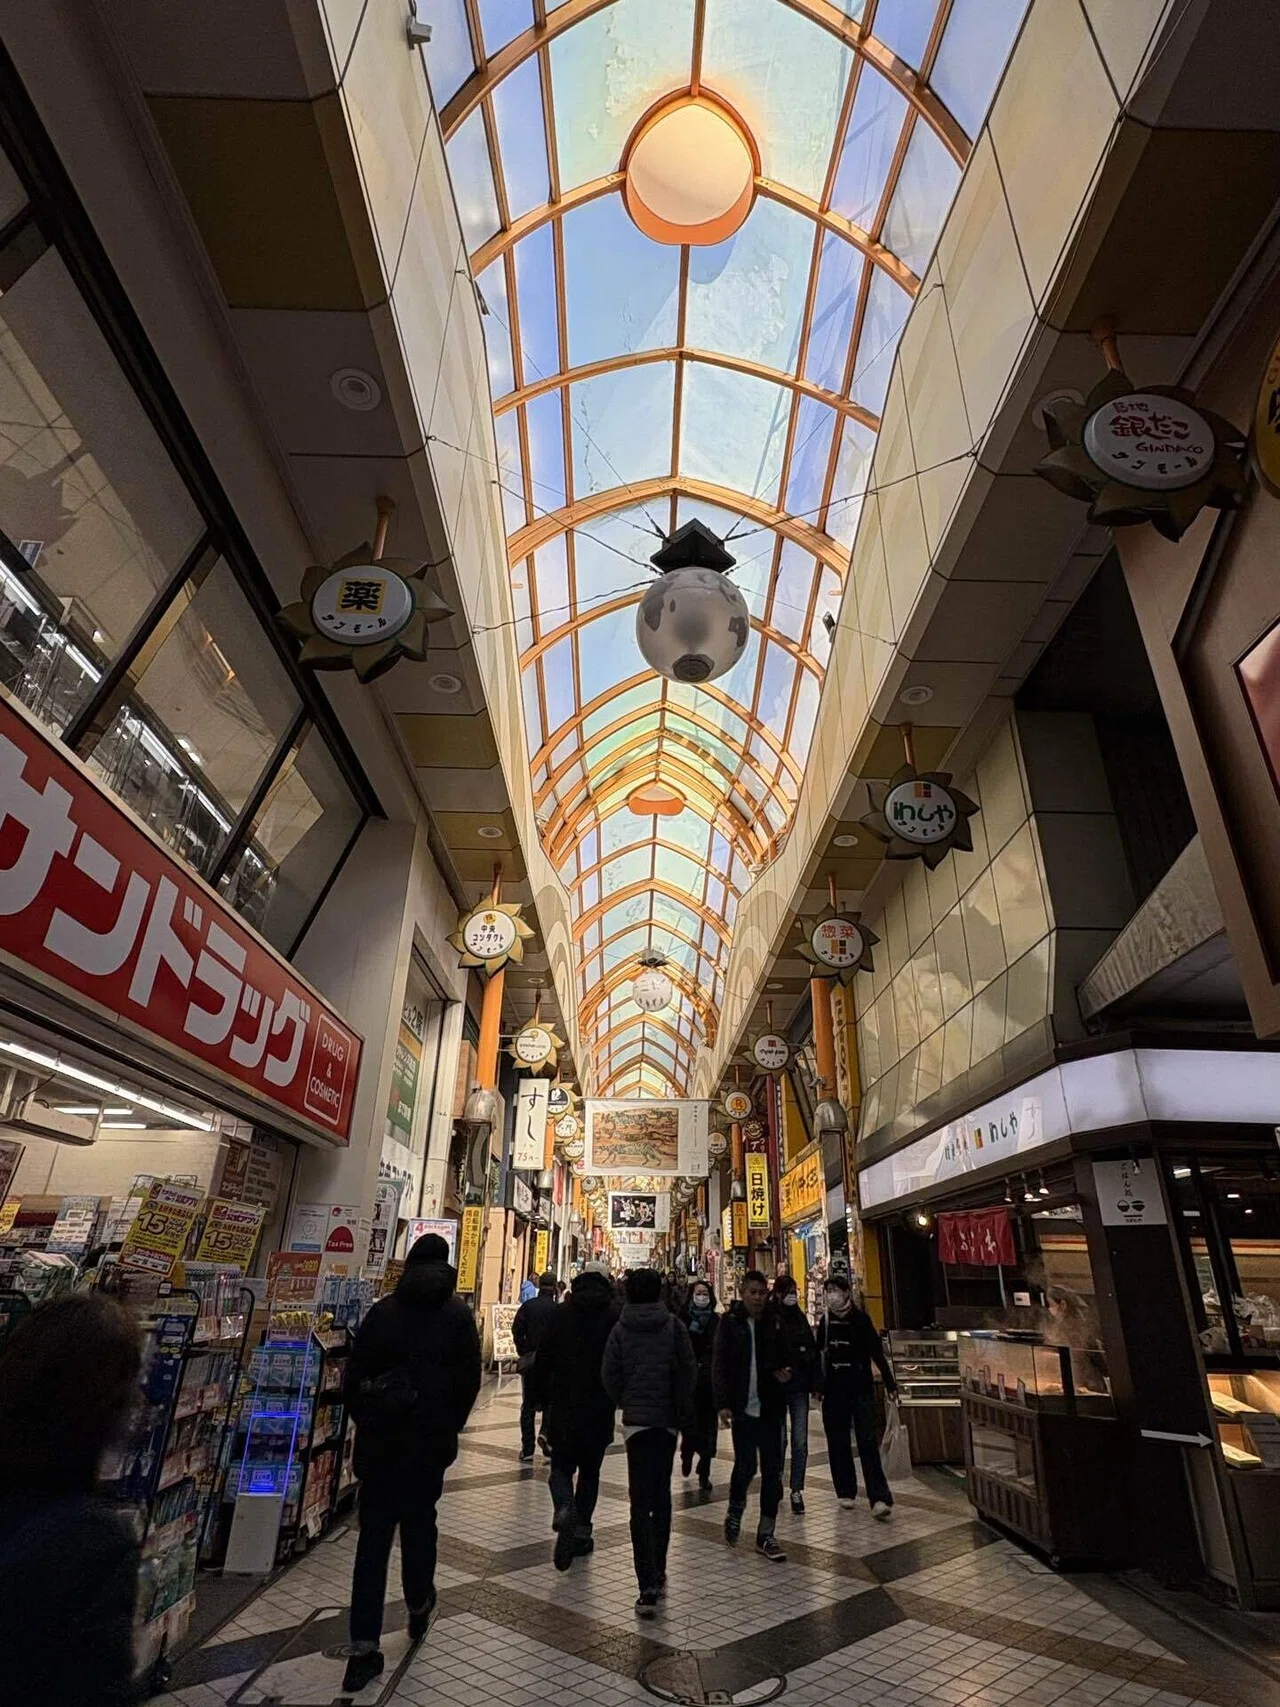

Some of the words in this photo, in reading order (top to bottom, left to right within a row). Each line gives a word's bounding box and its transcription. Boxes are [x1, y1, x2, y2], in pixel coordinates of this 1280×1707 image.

[1109, 412, 1190, 441] 銀だこ
[1136, 442, 1204, 454] GINDACO
[340, 581, 382, 610] 薬
[322, 614, 387, 634] サンモール
[893, 802, 954, 823] わしや
[0, 733, 311, 1088] サンドラッグ
[473, 934, 504, 942] コンタクト
[480, 925, 496, 933] 中央
[821, 924, 855, 939] 惣菜
[320, 1032, 345, 1062] DRUG
[325, 1068, 333, 1079] &
[309, 1080, 341, 1107] COSMETIC
[521, 1087, 544, 1141] すし
[988, 1111, 1018, 1143] わしや
[751, 1173, 766, 1216] 日焼け
[415, 1221, 425, 1233] 4
